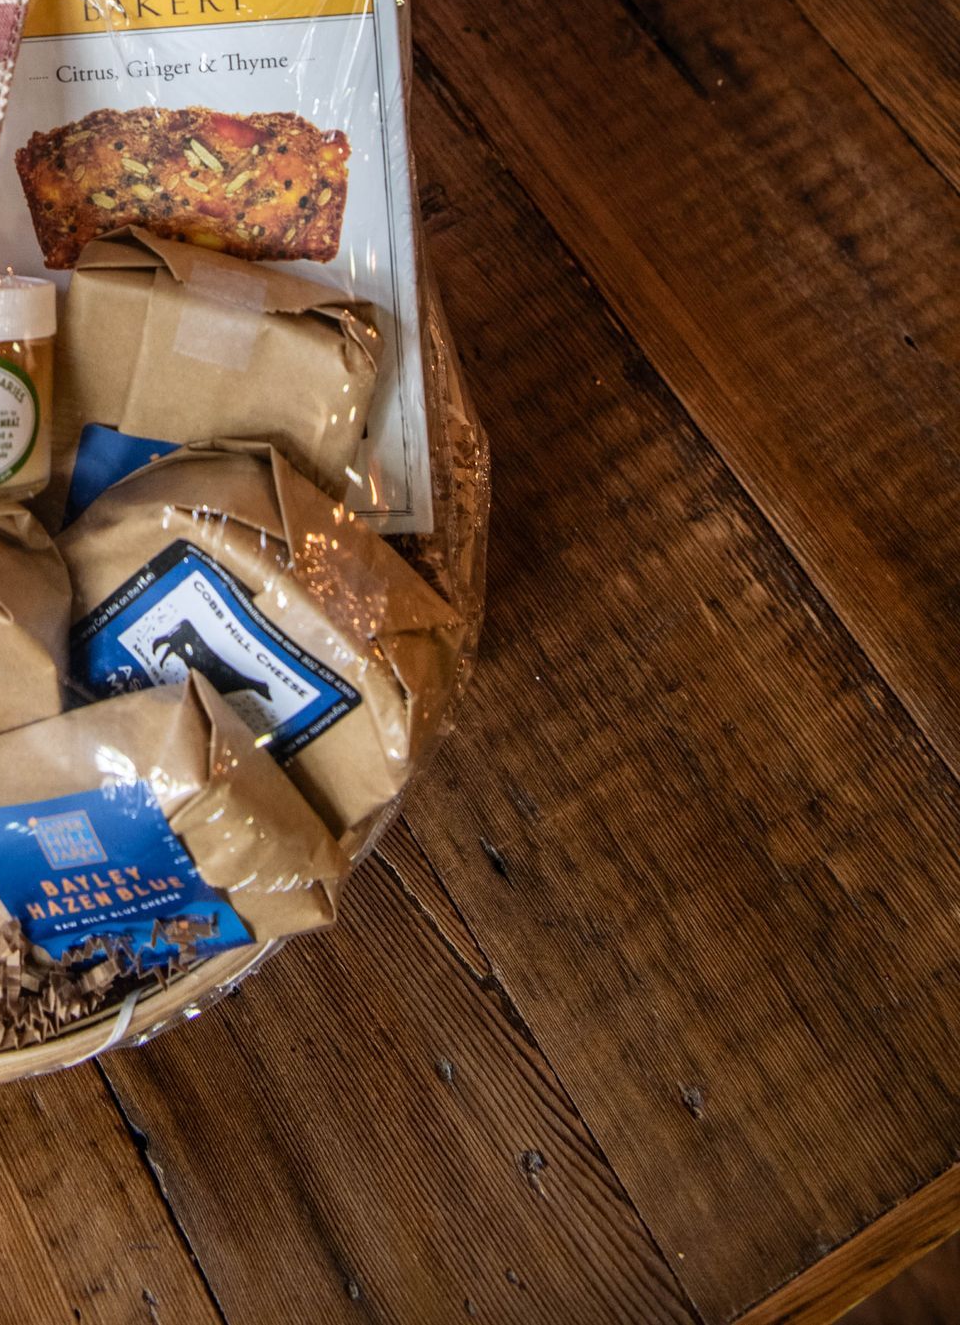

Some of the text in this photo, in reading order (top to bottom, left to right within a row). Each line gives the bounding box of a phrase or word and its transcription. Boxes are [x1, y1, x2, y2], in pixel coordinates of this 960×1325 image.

[55, 52, 289, 85] Citrus, Ginger & Thyme
[193, 579, 311, 699] COBB HILL CHEESE
[26, 876, 186, 920] HAZEN BLUE
[40, 866, 141, 897] BAYLEY
[110, 906, 139, 919] BLUE
[140, 891, 182, 911] CHEESE
